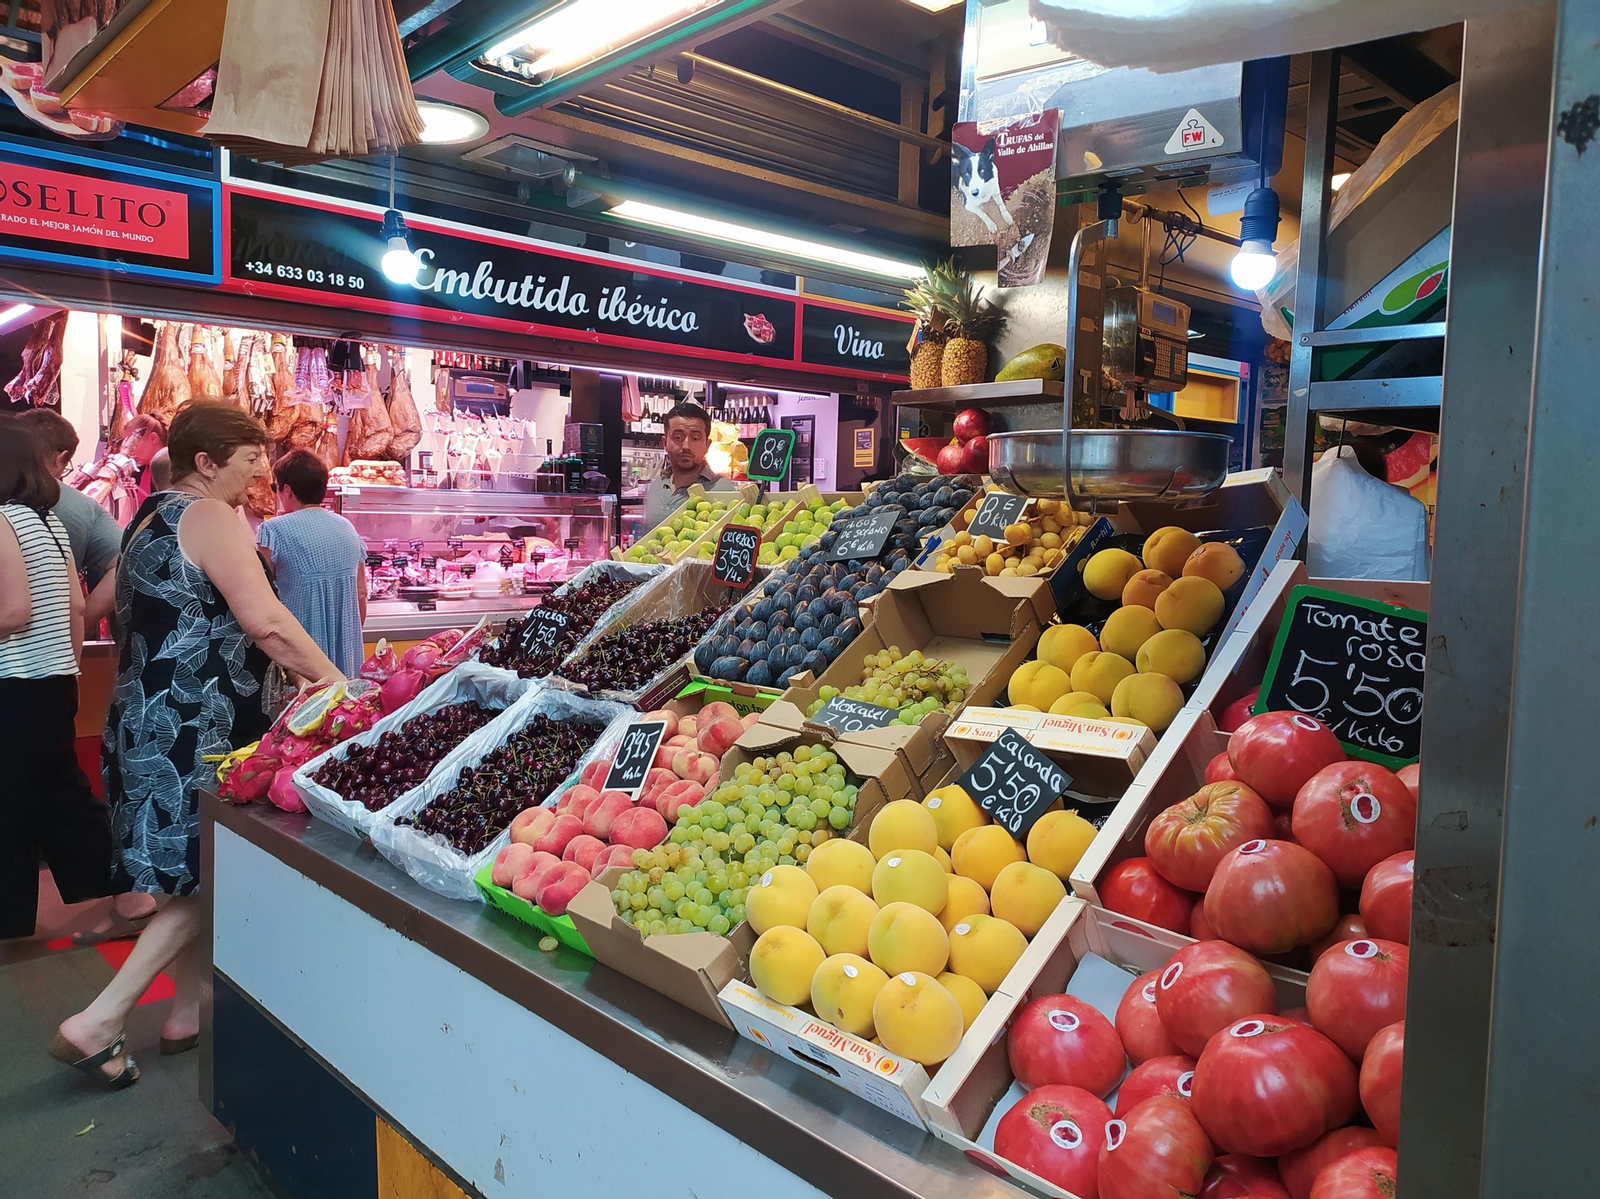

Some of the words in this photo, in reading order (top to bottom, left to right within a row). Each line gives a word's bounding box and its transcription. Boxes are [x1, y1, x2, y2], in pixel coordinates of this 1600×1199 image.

[997, 147, 1015, 157] Valle
[1016, 145, 1026, 154] de
[1027, 141, 1054, 153] Ahillas
[1034, 132, 1045, 141] del
[1184, 130, 1203, 144] FW
[29, 217, 40, 227] EL
[41, 219, 71, 232] MEJOR
[71, 223, 104, 237] JAMÓN
[105, 229, 121, 239] DEL
[121, 231, 155, 244] MUNDO
[245, 260, 273, 277] +34
[276, 264, 303, 281] 633
[306, 269, 324, 284] 03
[328, 272, 345, 287] 18
[348, 275, 365, 290] 50
[410, 247, 590, 316] Embutido
[597, 286, 700, 333] ibérico
[833, 324, 885, 360] Vino
[1301, 602, 1424, 647] Tomate
[827, 696, 890, 721] Moscatel
[998, 732, 1063, 794] Calanda
